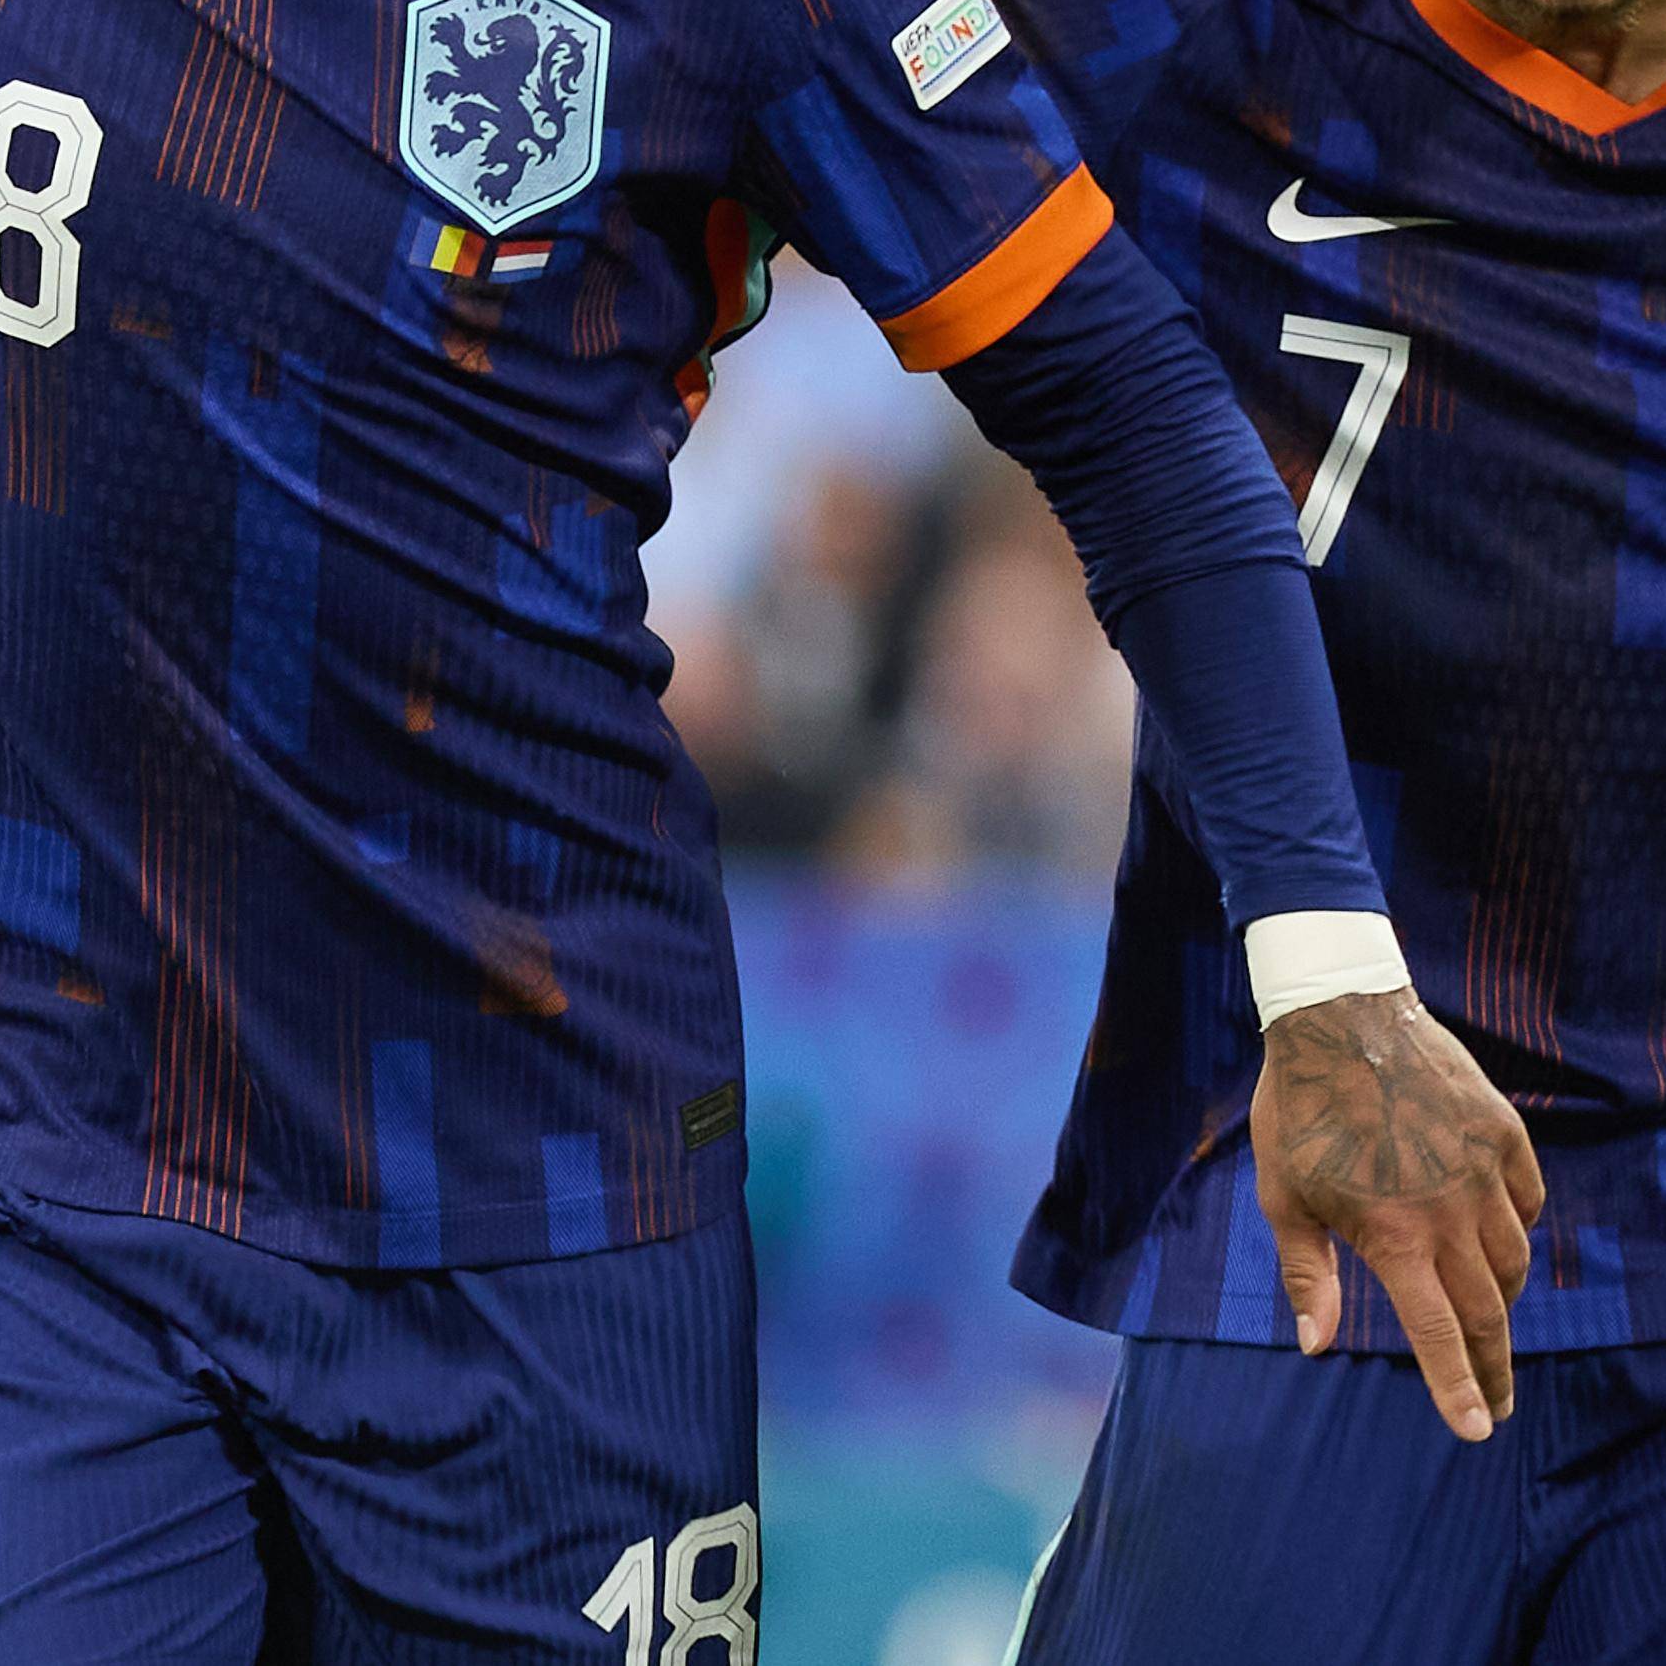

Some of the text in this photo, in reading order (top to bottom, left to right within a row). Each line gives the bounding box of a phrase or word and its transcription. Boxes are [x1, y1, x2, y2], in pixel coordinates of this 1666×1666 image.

[900, 23, 932, 57] UEFA
[1279, 313, 1411, 567] 7
[581, 1502, 758, 1666] 18
